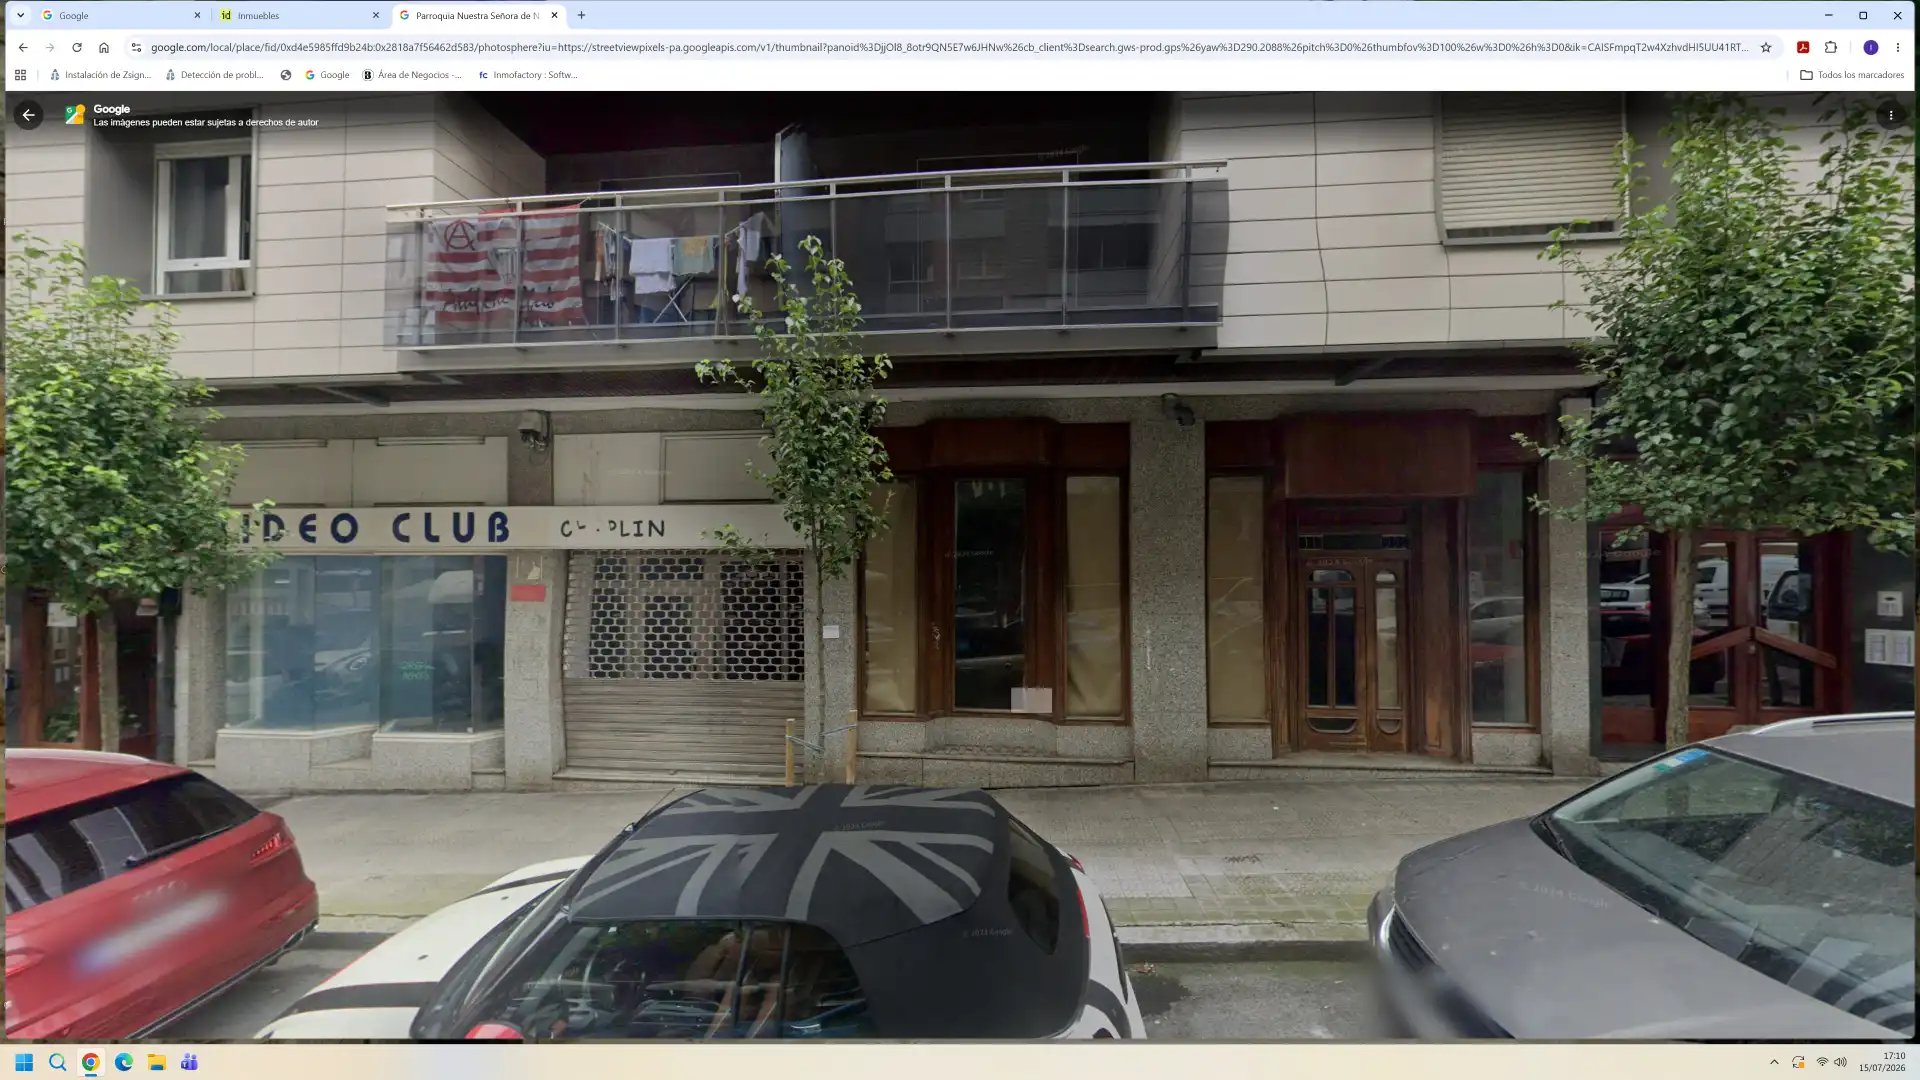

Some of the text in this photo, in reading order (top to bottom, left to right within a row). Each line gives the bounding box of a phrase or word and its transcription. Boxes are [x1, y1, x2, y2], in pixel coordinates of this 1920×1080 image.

[59, 11, 89, 22] Google
[221, 10, 232, 20] id
[238, 11, 280, 20] Inmuebles
[416, 11, 455, 22] Parroquia
[457, 11, 489, 20] Nuestra
[490, 11, 519, 20] Señora
[520, 11, 532, 20] de
[65, 69, 152, 82] Instalación de Zsign...
[181, 69, 264, 82] Detección de probl...
[320, 70, 350, 82] Google
[377, 68, 397, 79] Área
[398, 70, 410, 79] de
[411, 70, 450, 81] Negocios
[479, 71, 489, 80] fc
[493, 70, 543, 82] Inmofactory
[548, 70, 578, 80] Softw...
[1817, 70, 1905, 80] Todos los marcadores
[241, 511, 510, 544] IDEO CLUB
[1883, 1051, 1906, 1060] 17:10
[1859, 1063, 1906, 1072] 15/07/2026
